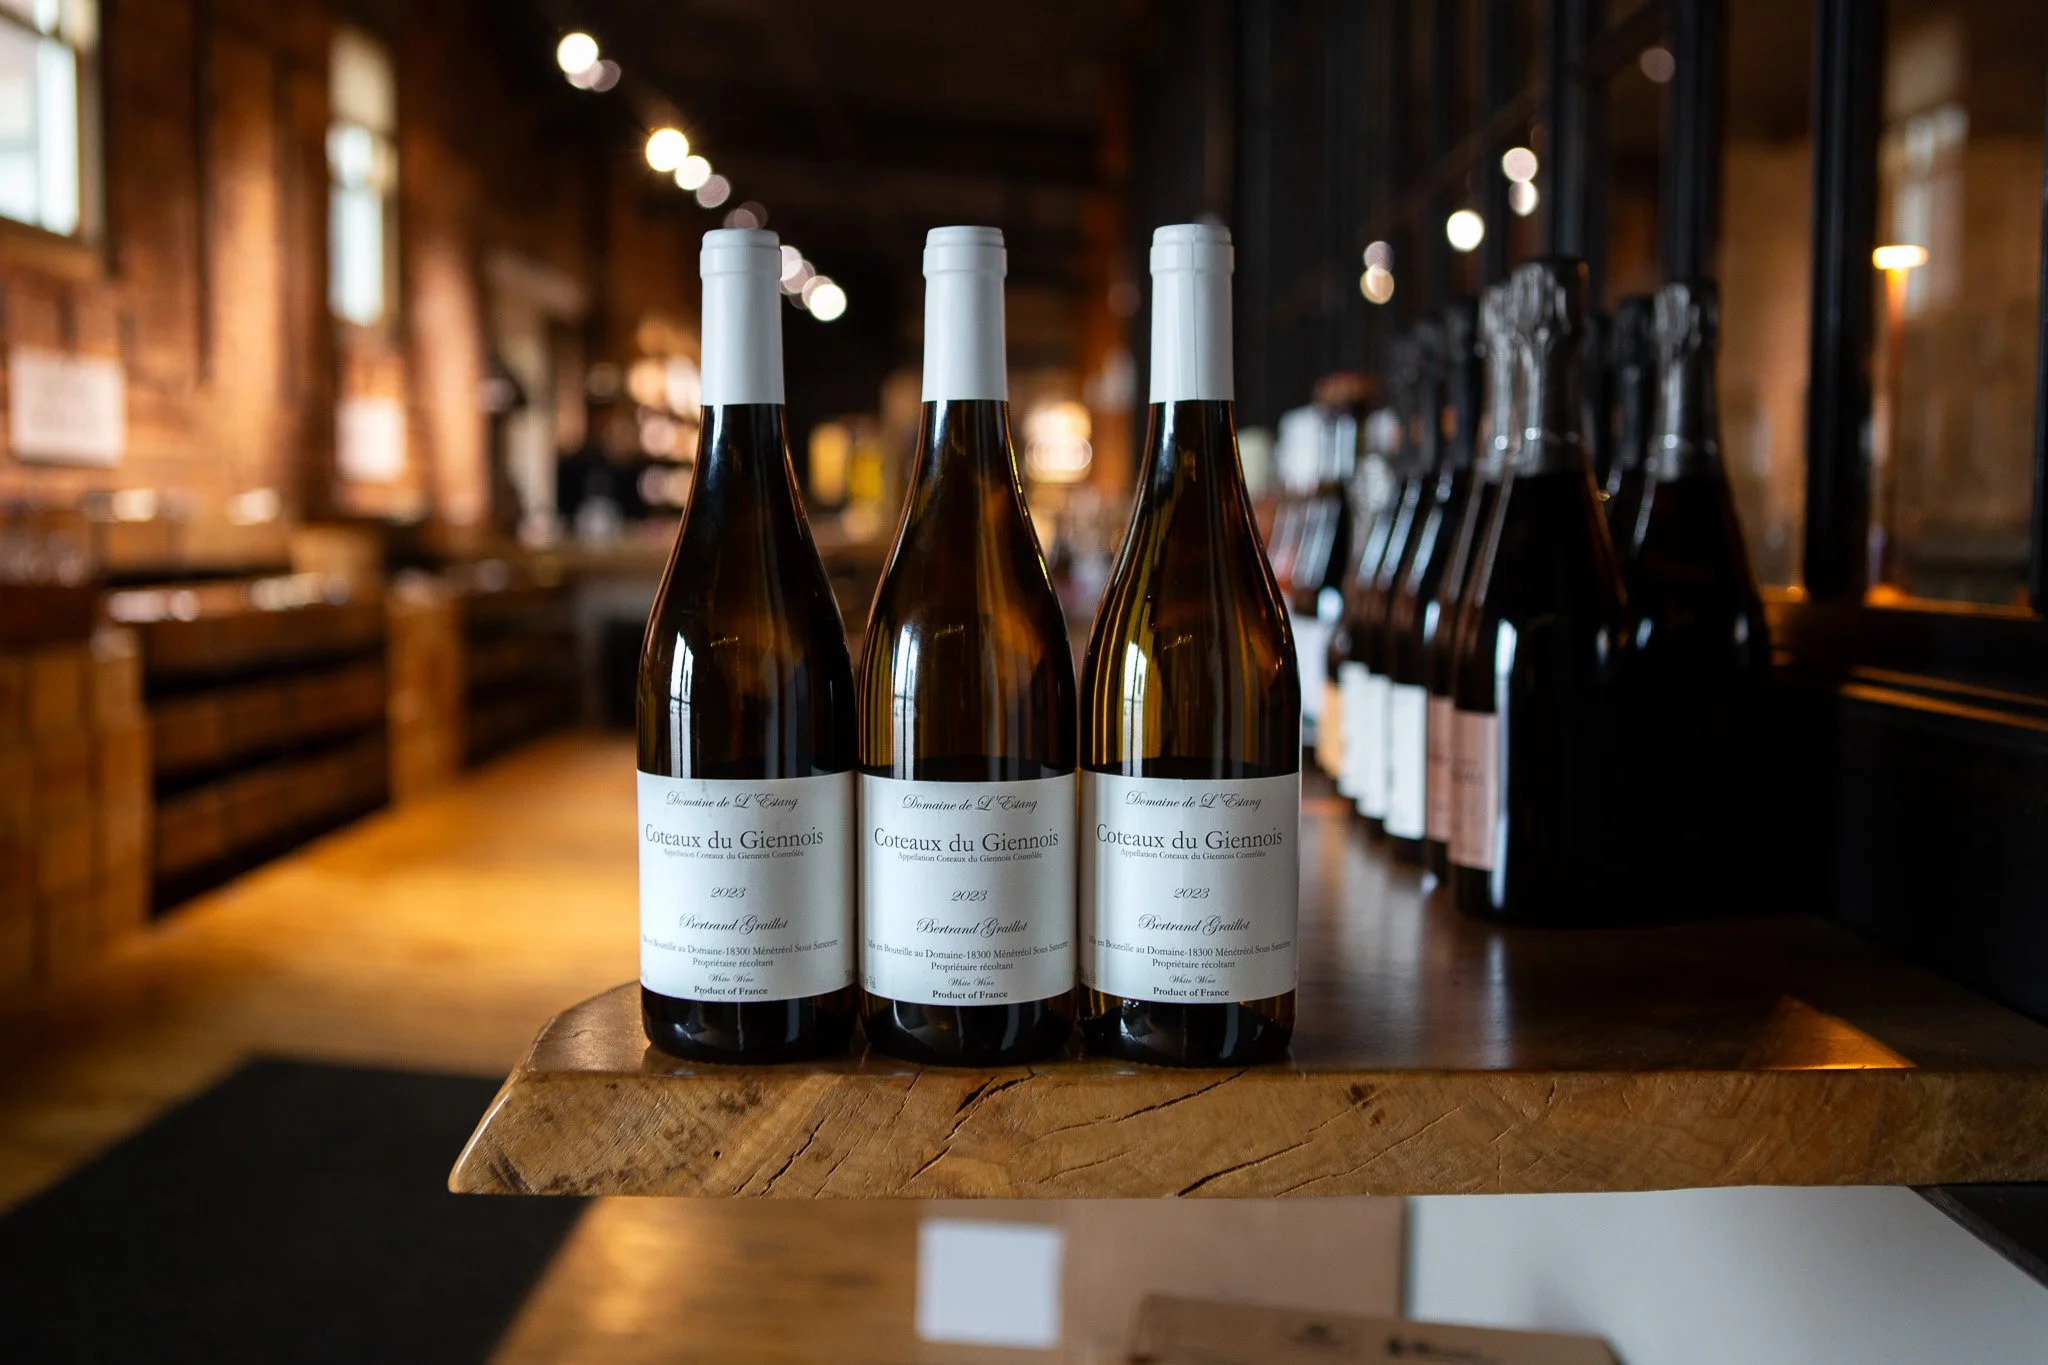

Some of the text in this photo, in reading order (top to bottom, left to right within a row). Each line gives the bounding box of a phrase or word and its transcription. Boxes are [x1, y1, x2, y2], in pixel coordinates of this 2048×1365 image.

[666, 790, 715, 808] Domaine
[717, 796, 730, 807] de
[902, 793, 957, 810] Domaine
[958, 798, 973, 810] de
[1125, 790, 1179, 808] Domaine
[1181, 796, 1196, 808] de
[645, 823, 824, 849] Coteaux du Giennois
[874, 827, 1059, 852] Coteaux du Giennois
[1096, 823, 1283, 850] Coteaux du Giennois
[696, 851, 724, 860] Coteaux
[726, 852, 736, 860] du
[737, 851, 770, 860] Giennois
[936, 854, 966, 863] Coteaux
[968, 854, 978, 863] du
[979, 854, 1012, 863] Giennois
[1159, 851, 1189, 860] Coteaux
[1191, 852, 1201, 860] du
[1202, 851, 1235, 860] Giennois
[710, 886, 747, 899] 2023
[951, 890, 988, 901] 2023
[1173, 887, 1211, 899] 2023
[679, 912, 789, 935] Bertrand Graillot
[916, 917, 1028, 938] Bertrand Graillot
[1138, 913, 1250, 936] Bertrand Graillot
[687, 945, 751, 956] Domaine-18300
[752, 945, 793, 956] Ménétréol
[794, 943, 812, 953] Sous
[925, 949, 992, 960] Domaine-18300
[993, 947, 1032, 958] Ménétréol
[1147, 946, 1213, 957] Domaine-18300
[1215, 946, 1254, 957] Ménétréol
[1254, 945, 1270, 954] Sous
[692, 957, 774, 968] Propriétaire récoltant
[931, 962, 1014, 972] Propriétaire récoltant
[1152, 958, 1236, 970] Propriétaire récoltant
[708, 973, 754, 983] White Wine
[948, 977, 995, 987] White Wine
[1169, 974, 1217, 984] White Wine
[694, 985, 768, 995] Product of France
[932, 990, 1009, 1000] Product of France
[1153, 986, 1230, 997] Product of France
